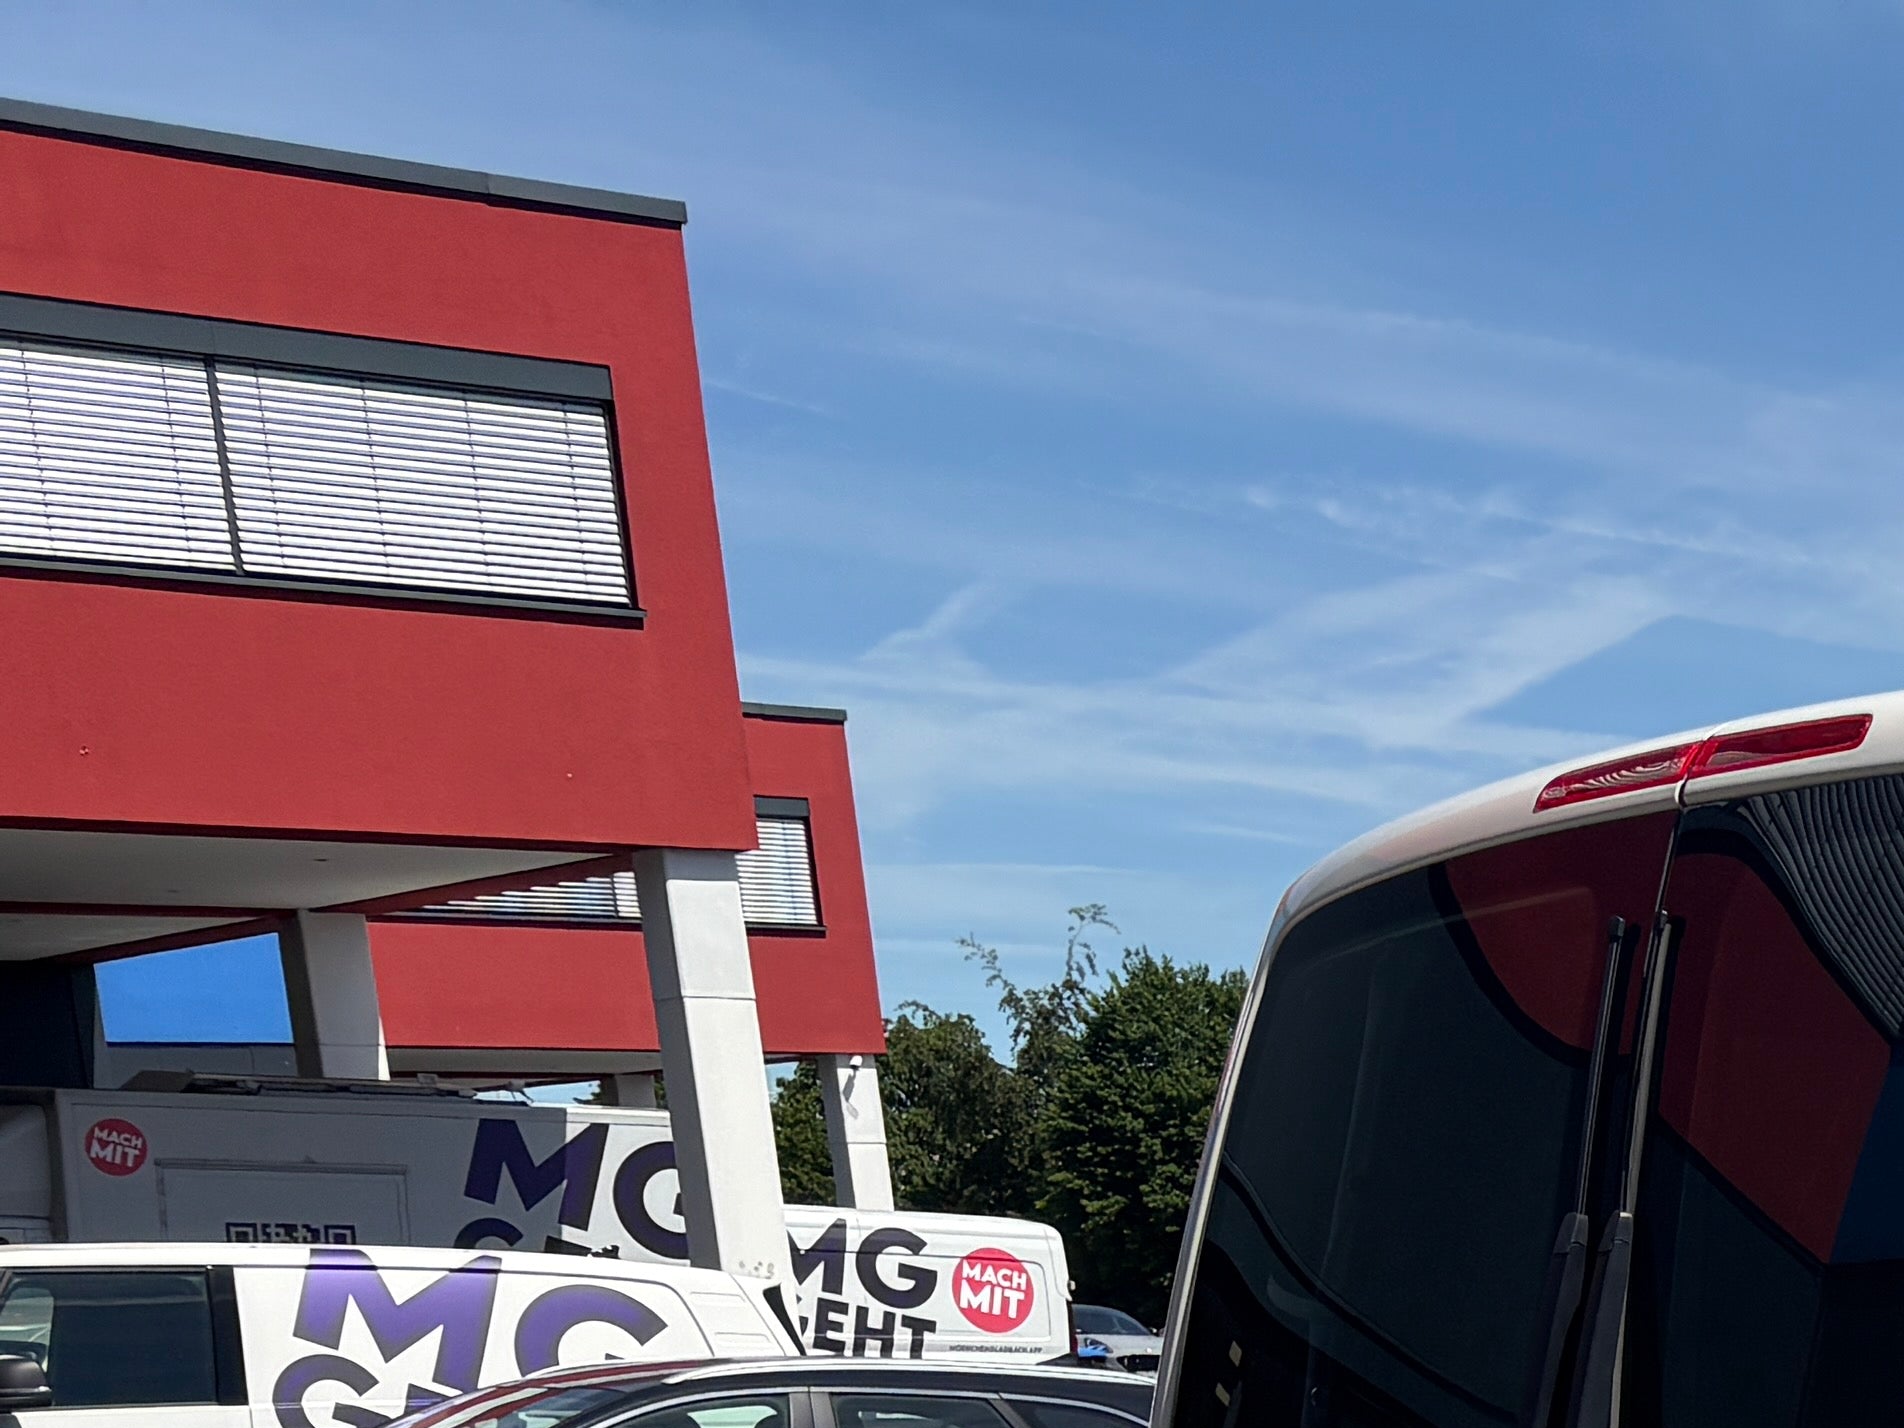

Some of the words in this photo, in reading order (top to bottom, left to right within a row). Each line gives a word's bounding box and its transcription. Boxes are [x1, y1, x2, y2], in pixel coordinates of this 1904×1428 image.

[90, 1138, 140, 1168] MIT
[94, 1126, 142, 1149] MACH
[961, 1258, 1028, 1291] MACH
[959, 1279, 1025, 1319] MIT
[798, 1296, 937, 1359] EHT
